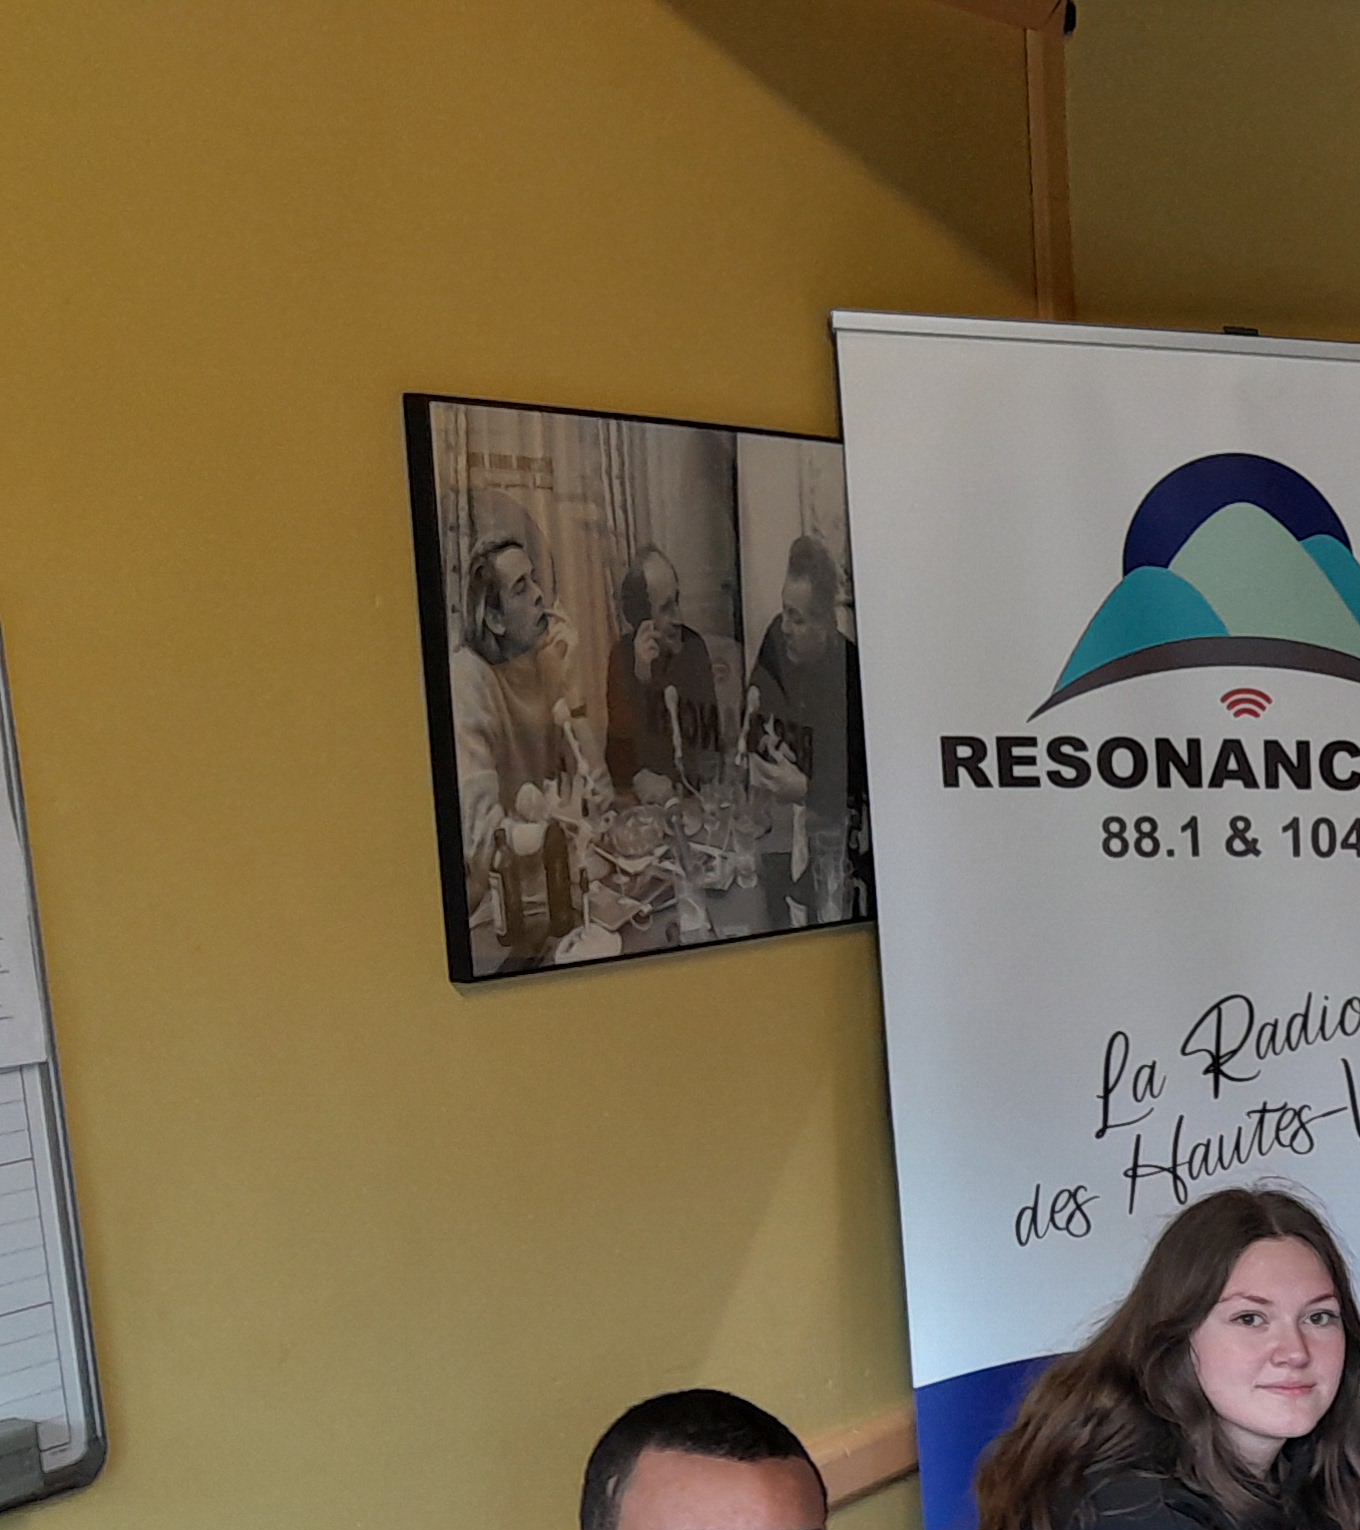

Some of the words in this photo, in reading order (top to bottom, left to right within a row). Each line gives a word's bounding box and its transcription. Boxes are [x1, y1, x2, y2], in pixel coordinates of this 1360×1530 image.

[1100, 815, 1201, 859] 88.1
[1225, 815, 1262, 859] &
[1094, 1030, 1167, 1140] La
[1015, 1183, 1101, 1247] des
